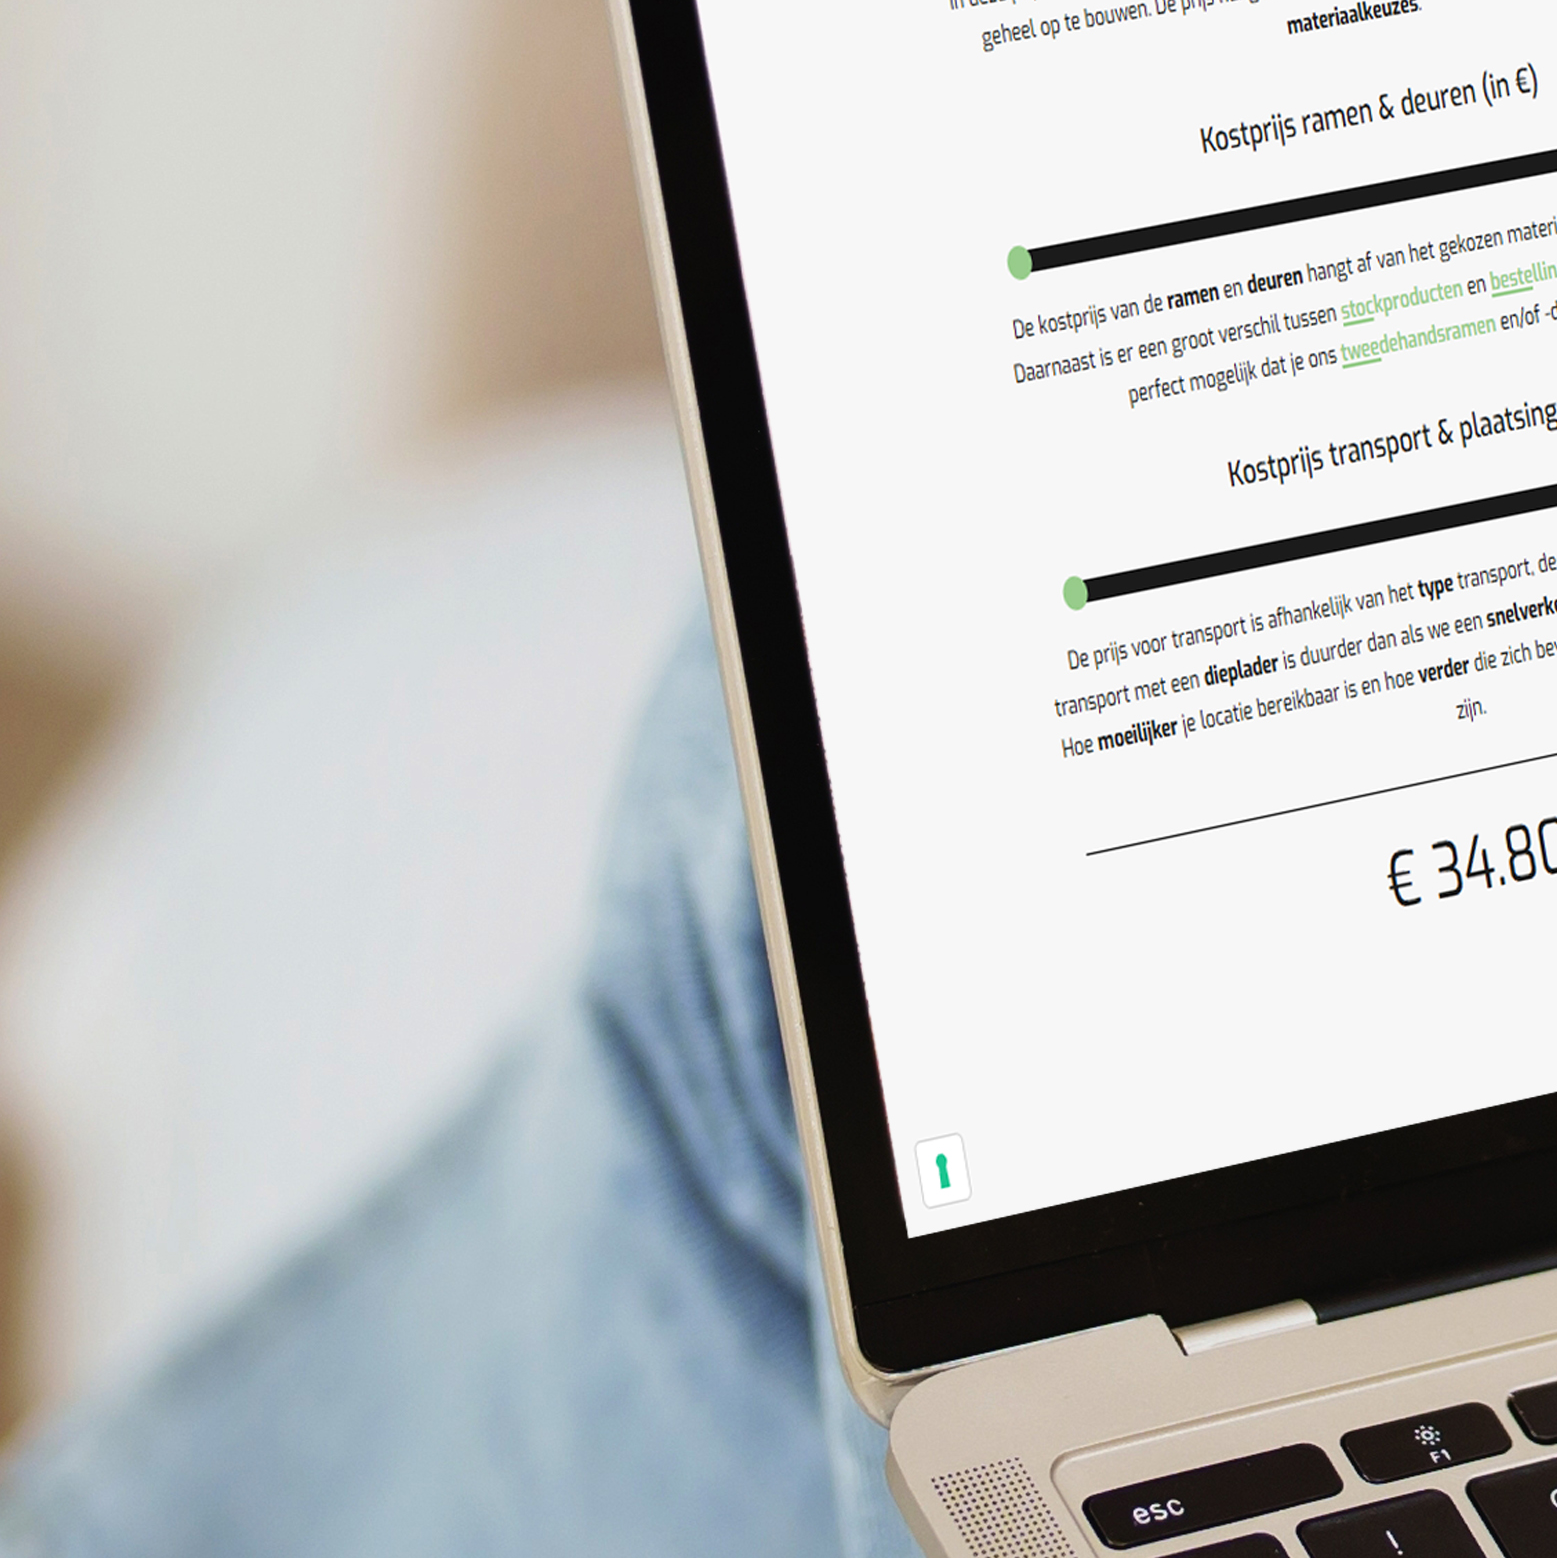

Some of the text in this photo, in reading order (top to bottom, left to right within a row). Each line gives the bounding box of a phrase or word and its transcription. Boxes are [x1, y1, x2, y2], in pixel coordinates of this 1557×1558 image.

[1199, 112, 1298, 154] Kostprijs
[1300, 102, 1374, 135] ramen
[1400, 83, 1477, 116] deuren
[1481, 70, 1511, 108] (in
[1514, 62, 1539, 100] €)
[1012, 350, 1097, 384] Daarnaast
[1098, 347, 1115, 367] is
[1116, 346, 1134, 364] er
[1137, 340, 1168, 360] een
[1170, 327, 1216, 359] groot
[1217, 312, 1283, 344] verschil
[1282, 307, 1338, 331] tussen
[1340, 282, 1464, 319] stockproducten
[1466, 277, 1488, 296] en
[1127, 376, 1187, 409] perfect
[1188, 360, 1259, 393] mogelijk
[1260, 356, 1288, 378] dat
[1289, 352, 1305, 377] je
[1307, 348, 1338, 368] ons
[1340, 318, 1497, 363] tweedehandsramen
[1499, 302, 1541, 331] en/of
[1226, 444, 1325, 488] Kostprijs
[1327, 424, 1434, 467] transport
[1066, 649, 1090, 670] De
[1092, 640, 1129, 671] prijs
[1130, 635, 1168, 657] voor
[1170, 616, 1248, 649] transport
[1249, 613, 1265, 633] is
[1267, 593, 1354, 629] afhankelijk
[1354, 591, 1385, 611] van
[1386, 581, 1415, 604] het
[1416, 577, 1455, 602] type
[1456, 558, 1535, 590] transport,
[1537, 552, 1557, 573] de
[1455, 697, 1488, 722] zijn.
[1386, 848, 1423, 908] €
[1429, 1448, 1451, 1463] F1
[1131, 1498, 1185, 1525] esc
[1386, 1531, 1403, 1555] !
